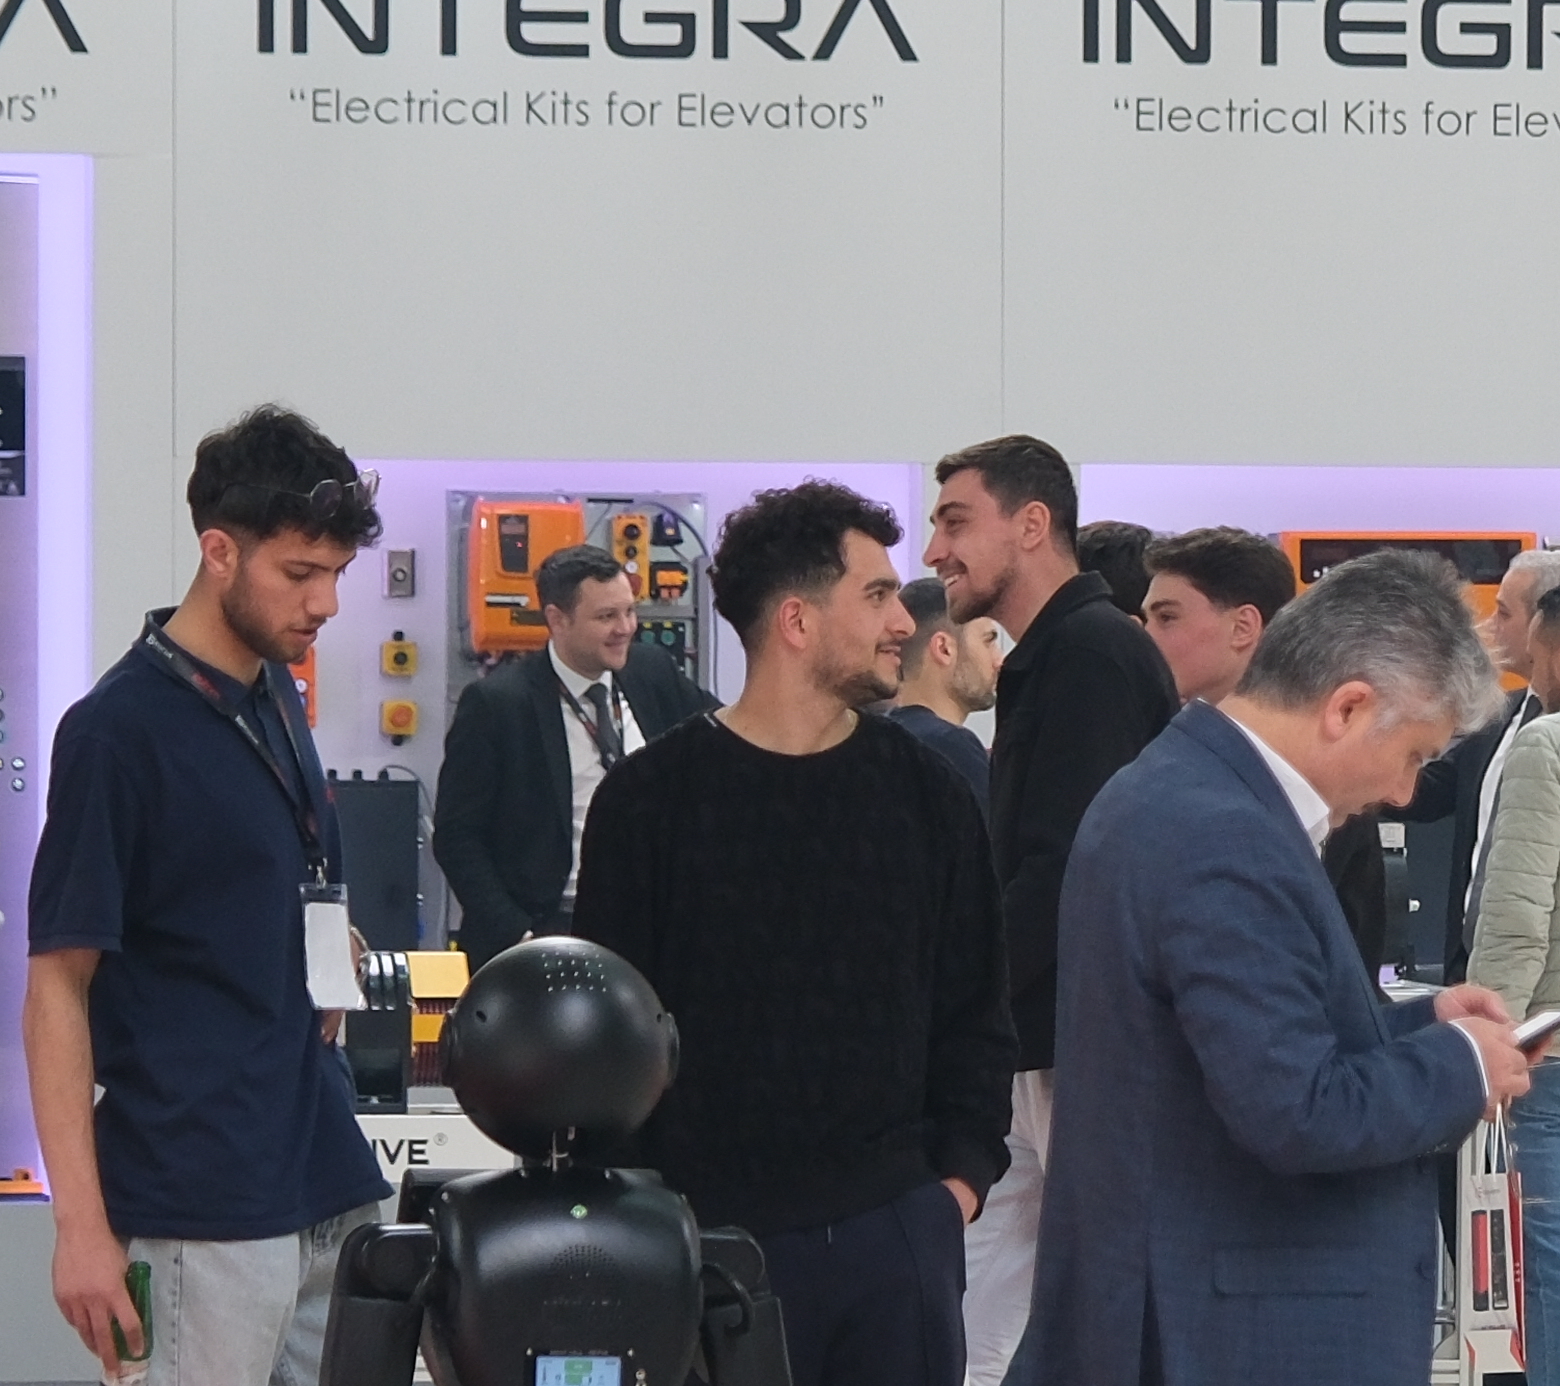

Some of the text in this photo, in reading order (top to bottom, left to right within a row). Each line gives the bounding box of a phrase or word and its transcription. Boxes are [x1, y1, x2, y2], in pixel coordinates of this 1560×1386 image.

[526, 91, 589, 126] Kits
[607, 91, 661, 127] for
[1344, 100, 1406, 135] Kits
[1424, 101, 1477, 136] for
